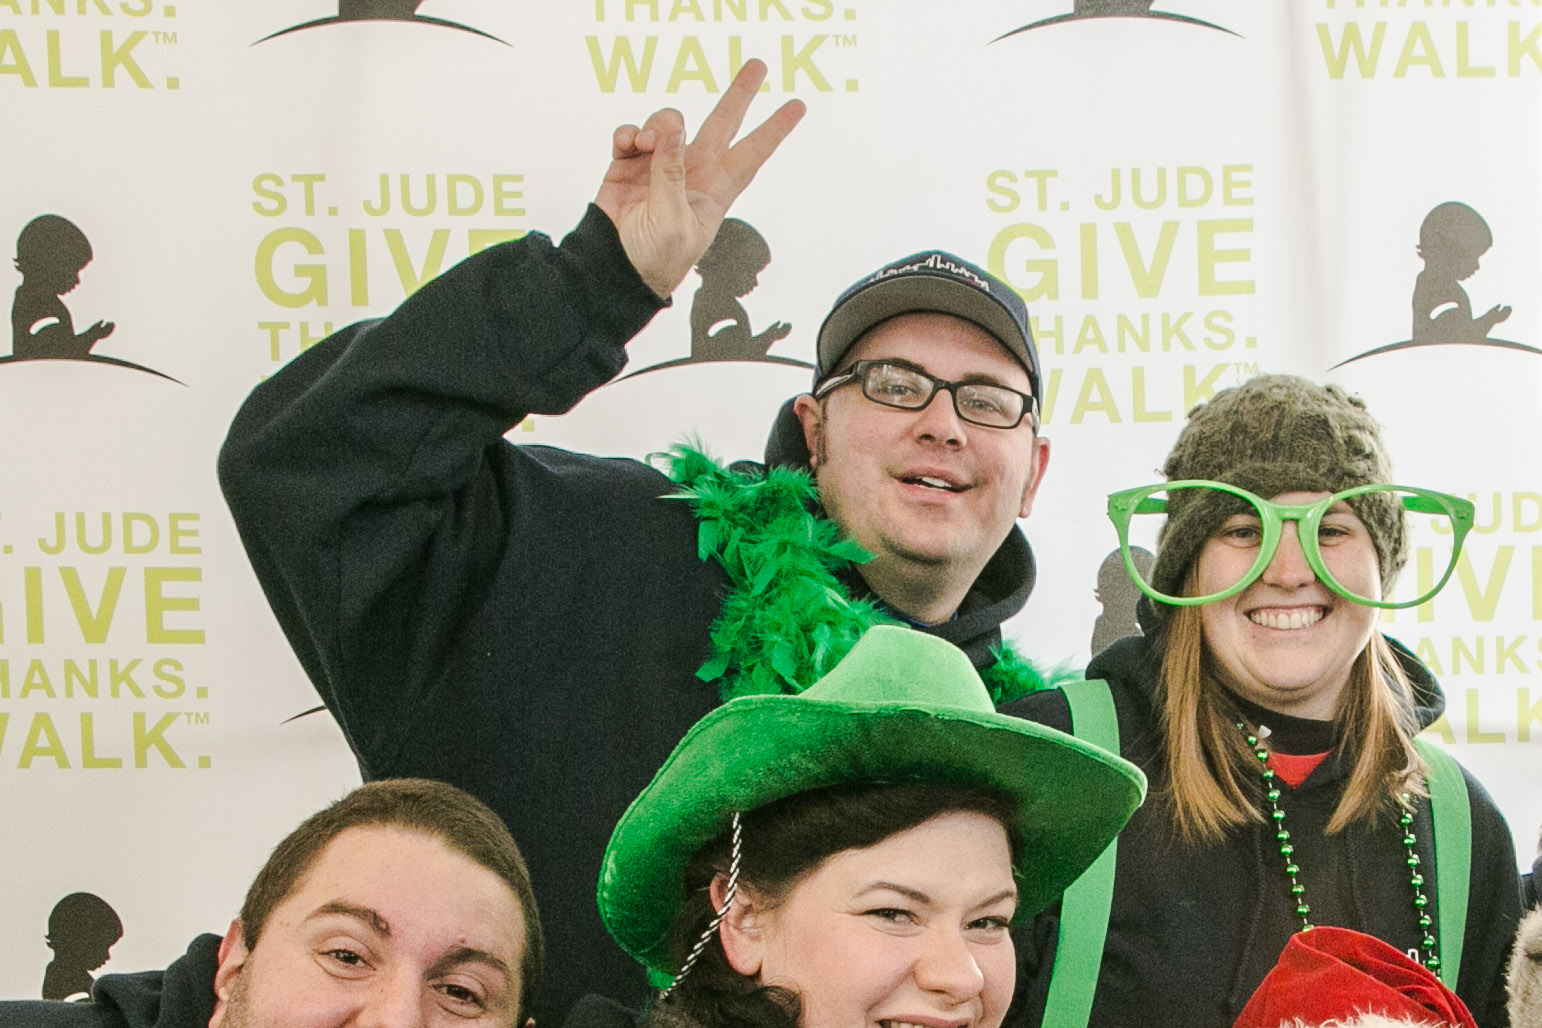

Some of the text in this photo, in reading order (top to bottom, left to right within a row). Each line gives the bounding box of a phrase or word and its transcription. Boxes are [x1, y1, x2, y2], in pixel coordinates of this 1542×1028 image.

[0, 28, 181, 90] ALK.
[250, 172, 527, 217] ST. JUDE
[985, 163, 1256, 214] ST. JUDE
[253, 226, 527, 309] GIV
[986, 217, 1257, 304] GIVE
[1029, 309, 1259, 356] HANKS.
[1039, 362, 1232, 426] ALK
[37, 512, 202, 555] JUDE
[0, 566, 206, 645] IVE
[0, 711, 212, 770] ALK.
